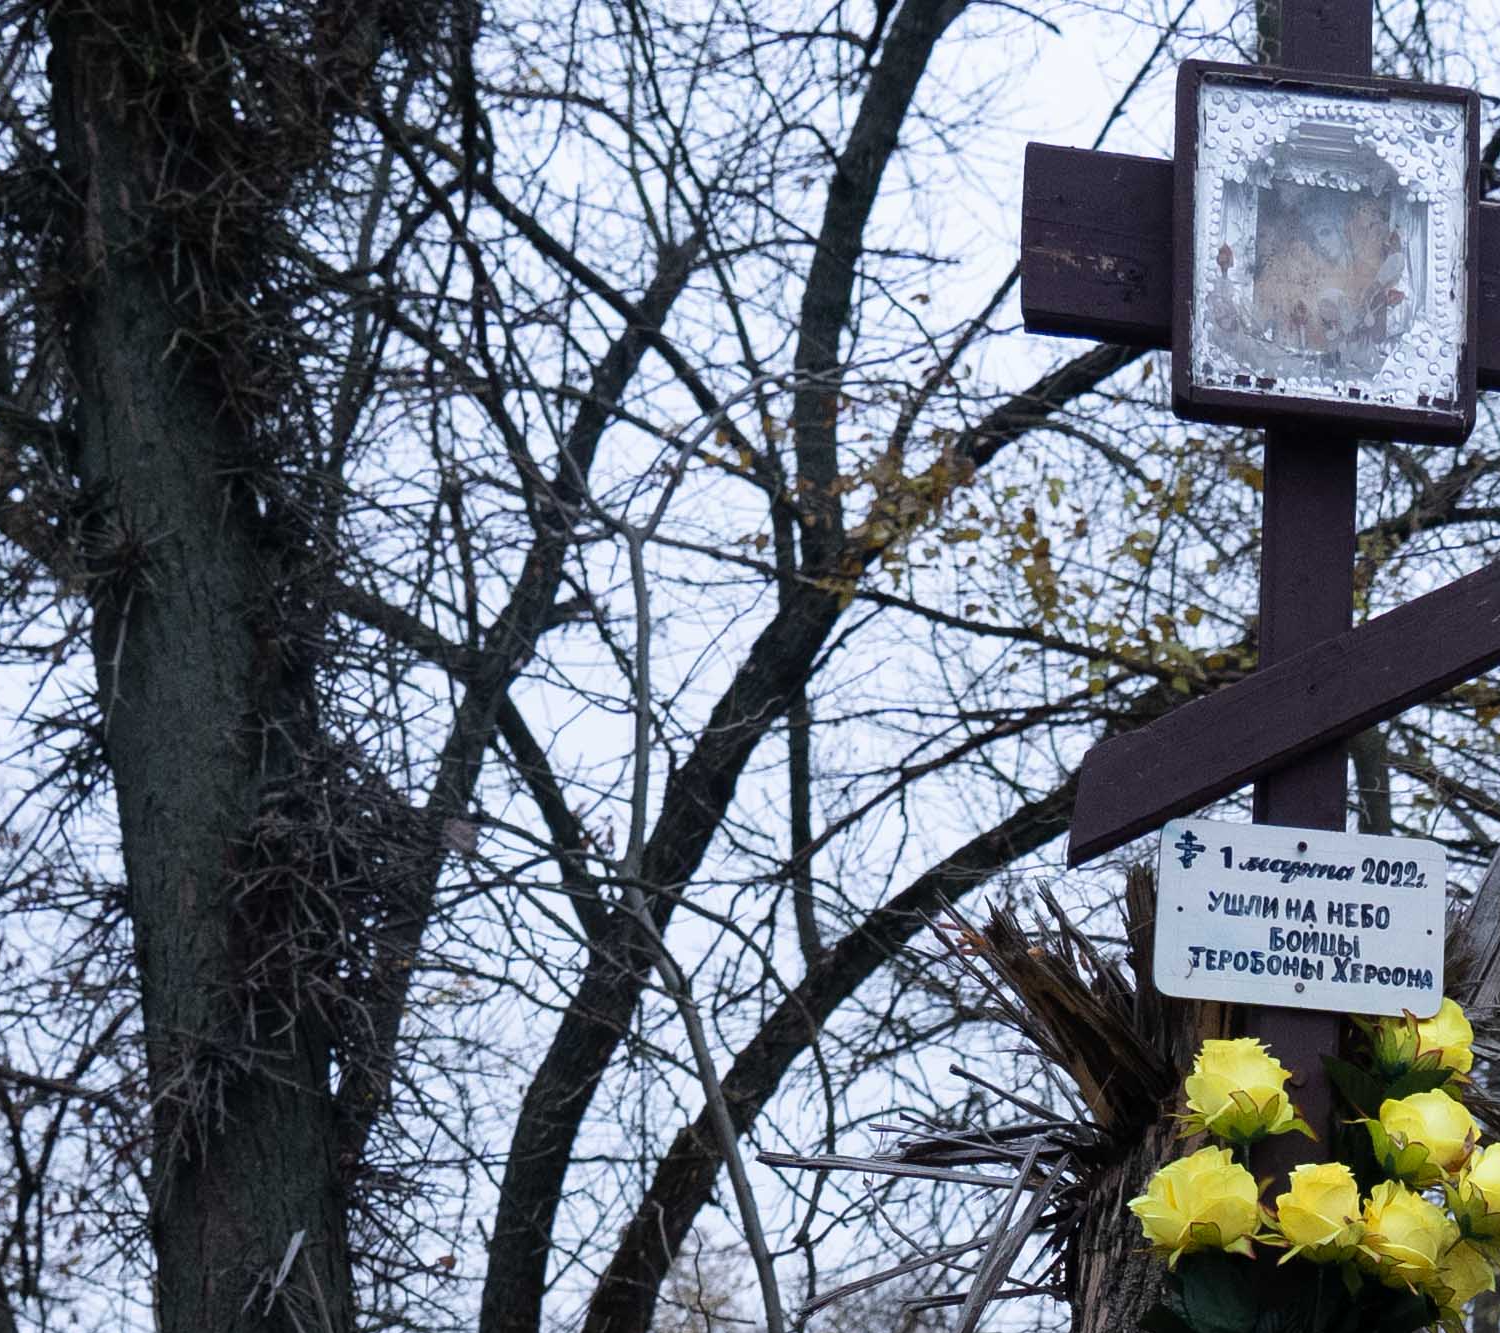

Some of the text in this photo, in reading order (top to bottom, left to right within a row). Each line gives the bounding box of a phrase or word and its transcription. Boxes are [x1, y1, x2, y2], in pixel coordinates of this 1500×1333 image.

[1220, 846, 1233, 869] 1
[1238, 856, 1356, 884] марта
[1208, 889, 1391, 930] УШЛИ НА НЕБО
[1268, 923, 1361, 959] БОЙЦЫ
[1188, 945, 1434, 990] ТЕРОБОНЫ ХЕРСОНА
